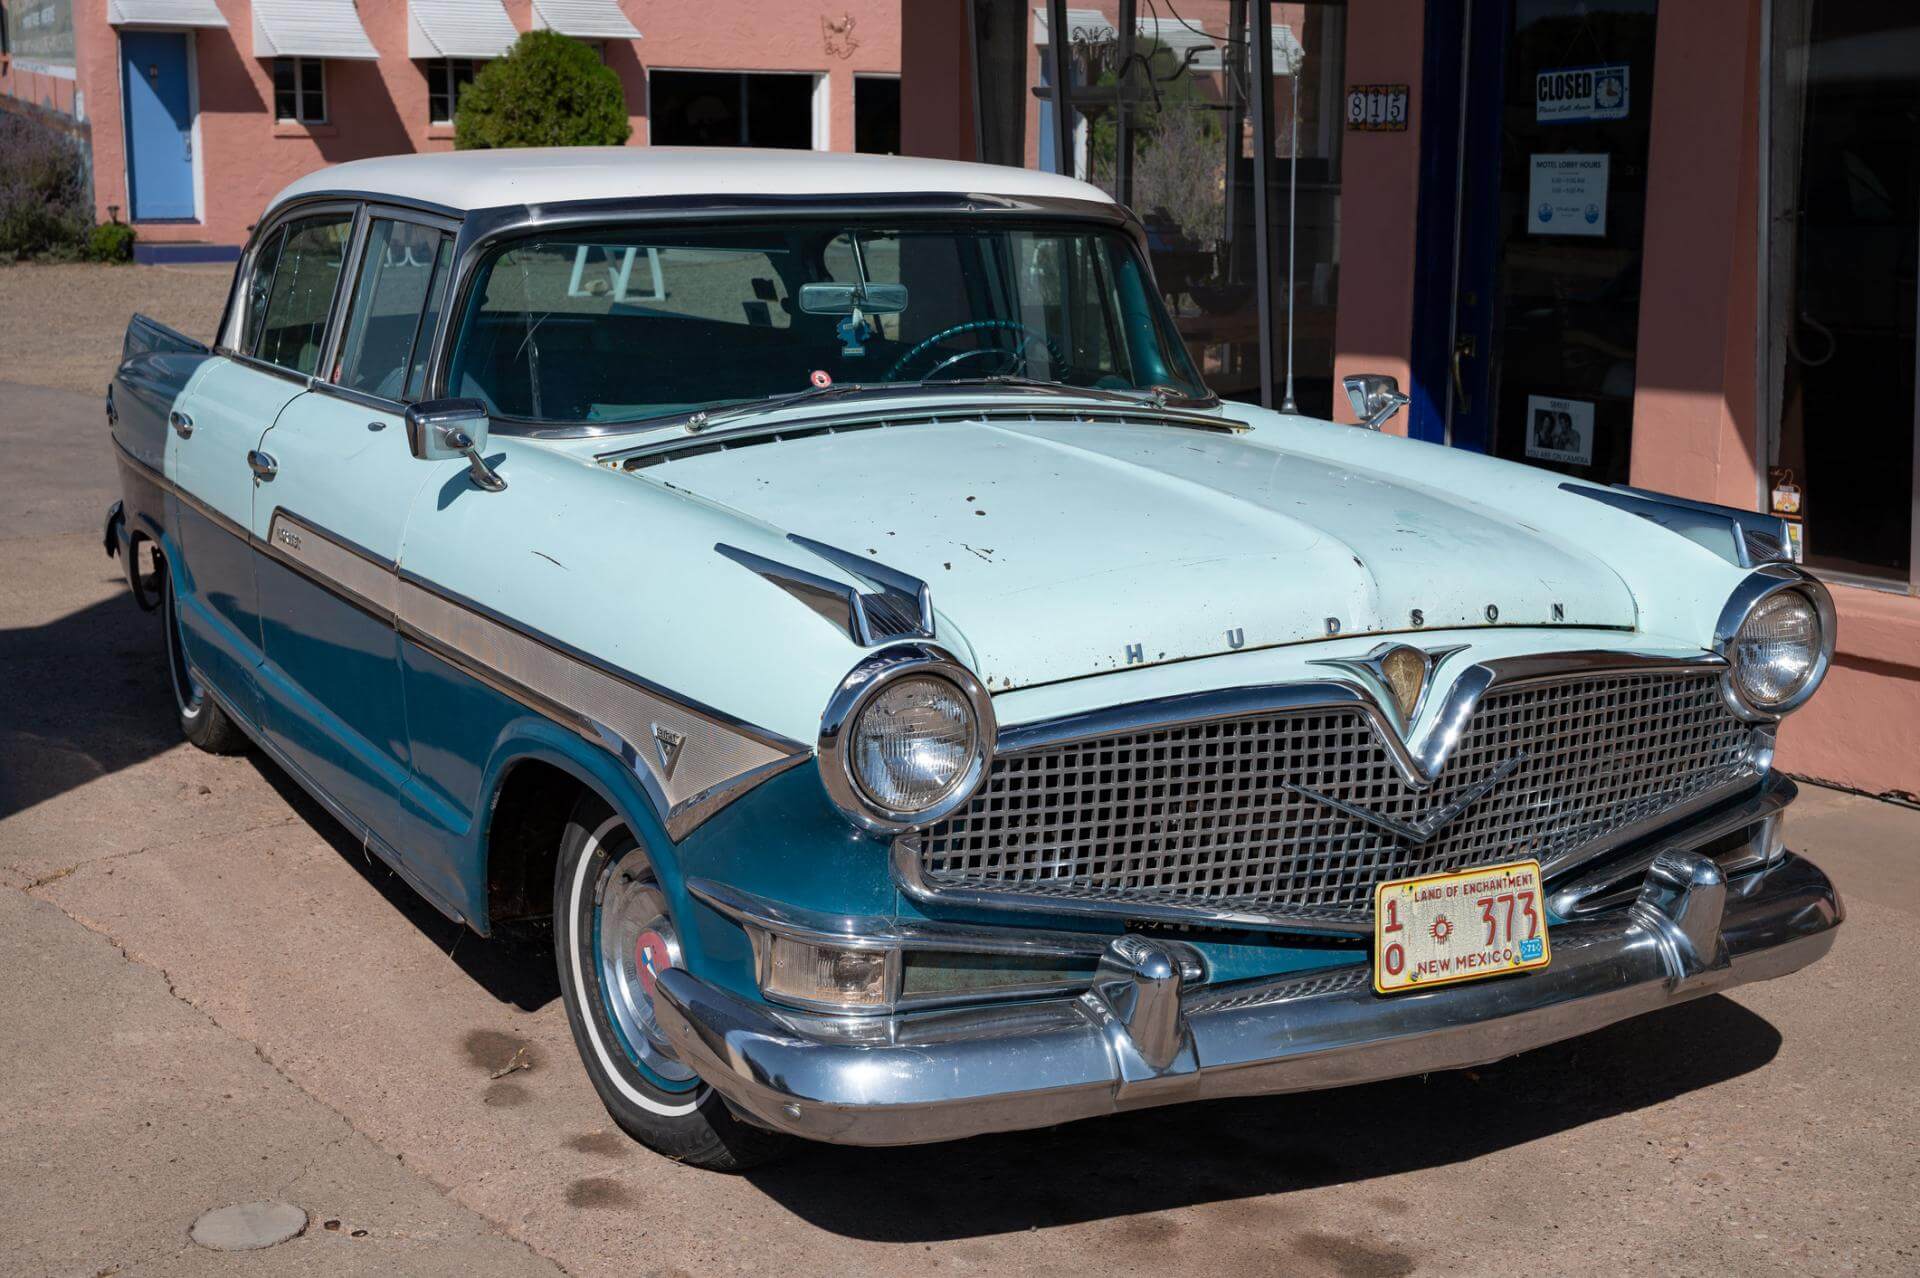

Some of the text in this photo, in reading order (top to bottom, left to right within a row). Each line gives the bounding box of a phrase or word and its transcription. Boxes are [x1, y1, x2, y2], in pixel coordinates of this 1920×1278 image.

[1538, 73, 1592, 101] CLOSED
[1352, 96, 1400, 118] 815
[1536, 160, 1601, 169] MOTEL LOBBY HOURS
[1562, 453, 1589, 464] CAMERA
[1126, 603, 1565, 664] HUDSON
[1414, 873, 1533, 903] LAND OF ENCHANTMENT
[1477, 891, 1538, 947] 373
[1417, 948, 1513, 975] NEW MEXICO
